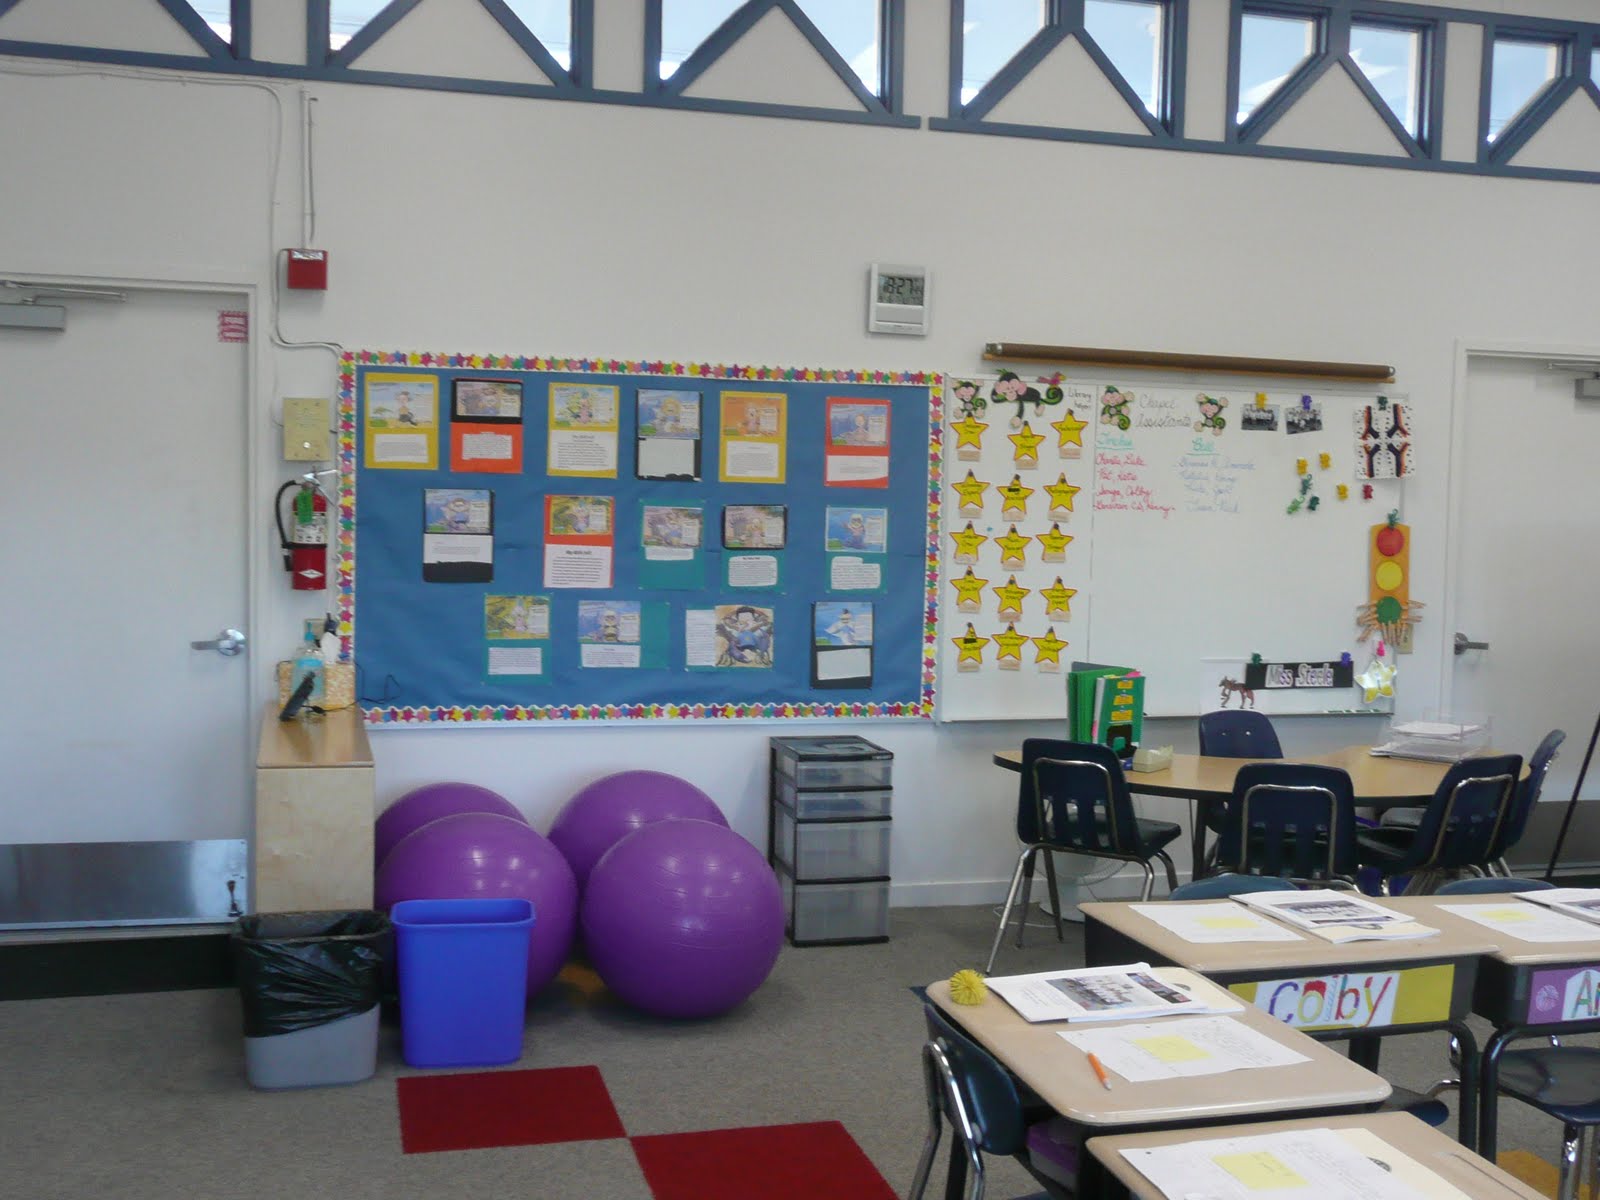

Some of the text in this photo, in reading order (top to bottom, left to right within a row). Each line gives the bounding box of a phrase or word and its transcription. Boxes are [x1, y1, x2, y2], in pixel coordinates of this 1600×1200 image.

[1265, 663, 1334, 687] Miss Steele
[1267, 973, 1393, 1028] Colby
